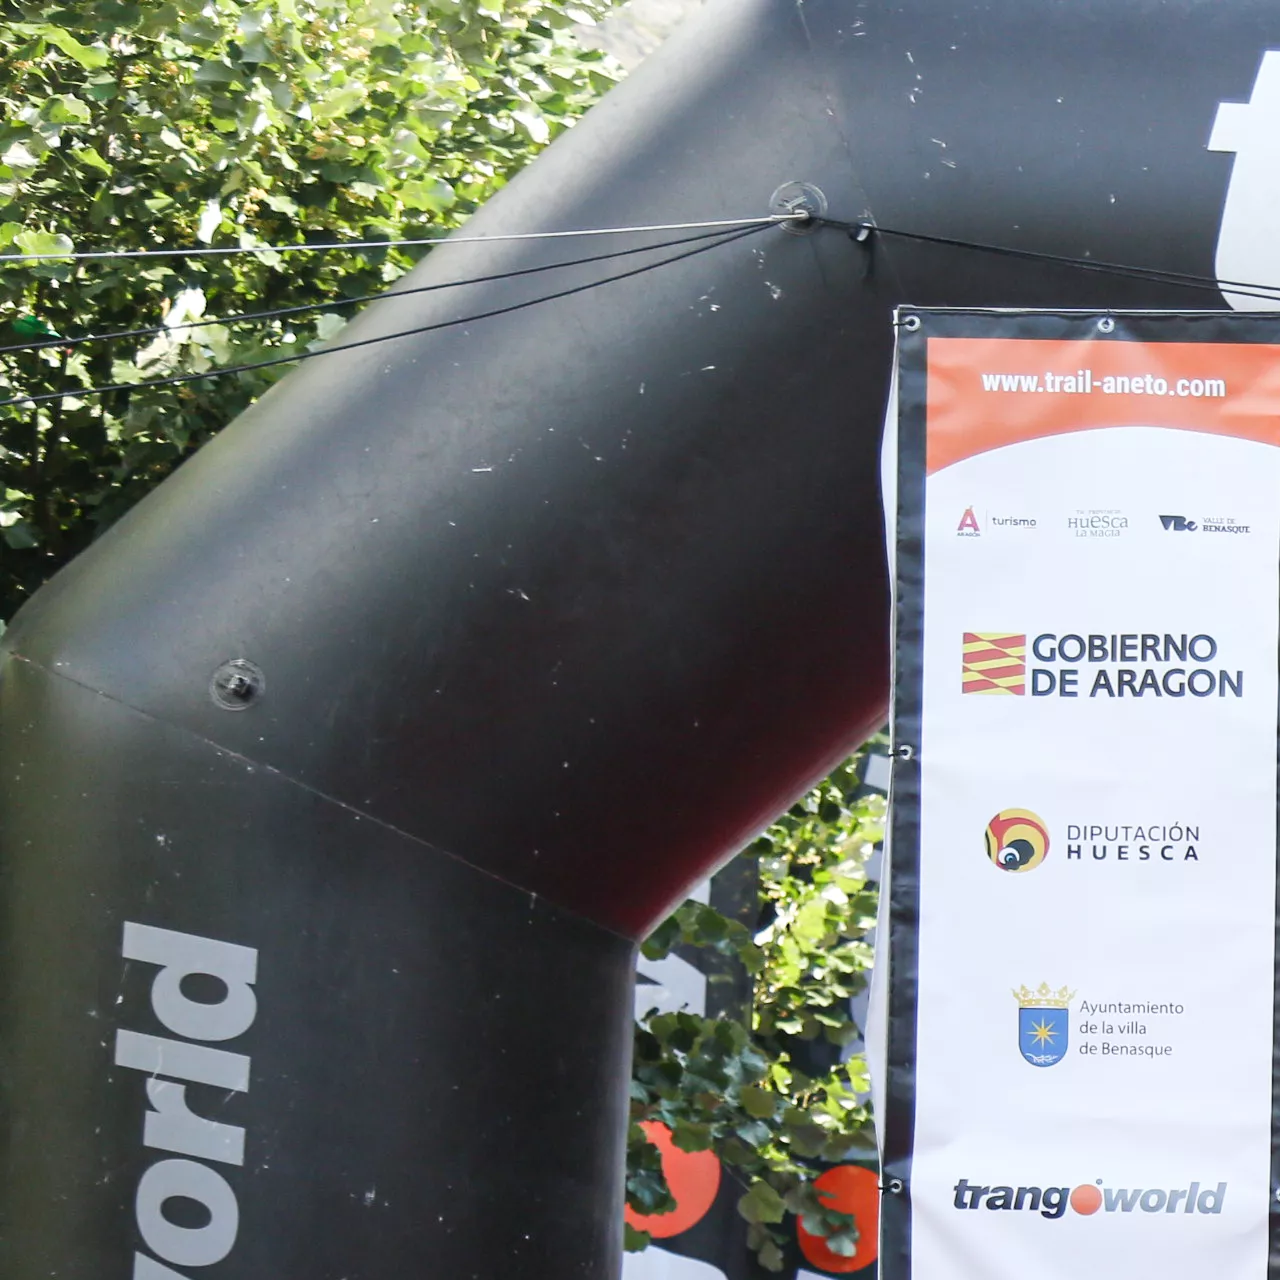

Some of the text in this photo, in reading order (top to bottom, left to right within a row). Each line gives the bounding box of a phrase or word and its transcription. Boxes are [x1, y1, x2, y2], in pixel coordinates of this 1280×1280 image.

[982, 370, 1226, 397] www.trail-aneto.com
[992, 516, 1037, 527] turismo
[1203, 525, 1251, 533] BENASQUE
[1032, 633, 1218, 662] GOBIERNO
[1032, 669, 1243, 698] DE ARAGON
[1067, 821, 1200, 842] DIPUTACIÓN
[1067, 845, 1200, 860] HUESCA
[1080, 999, 1184, 1017] Ayuntamiento
[1080, 1020, 1147, 1034] de la villa
[1079, 1041, 1172, 1058] de Benasque
